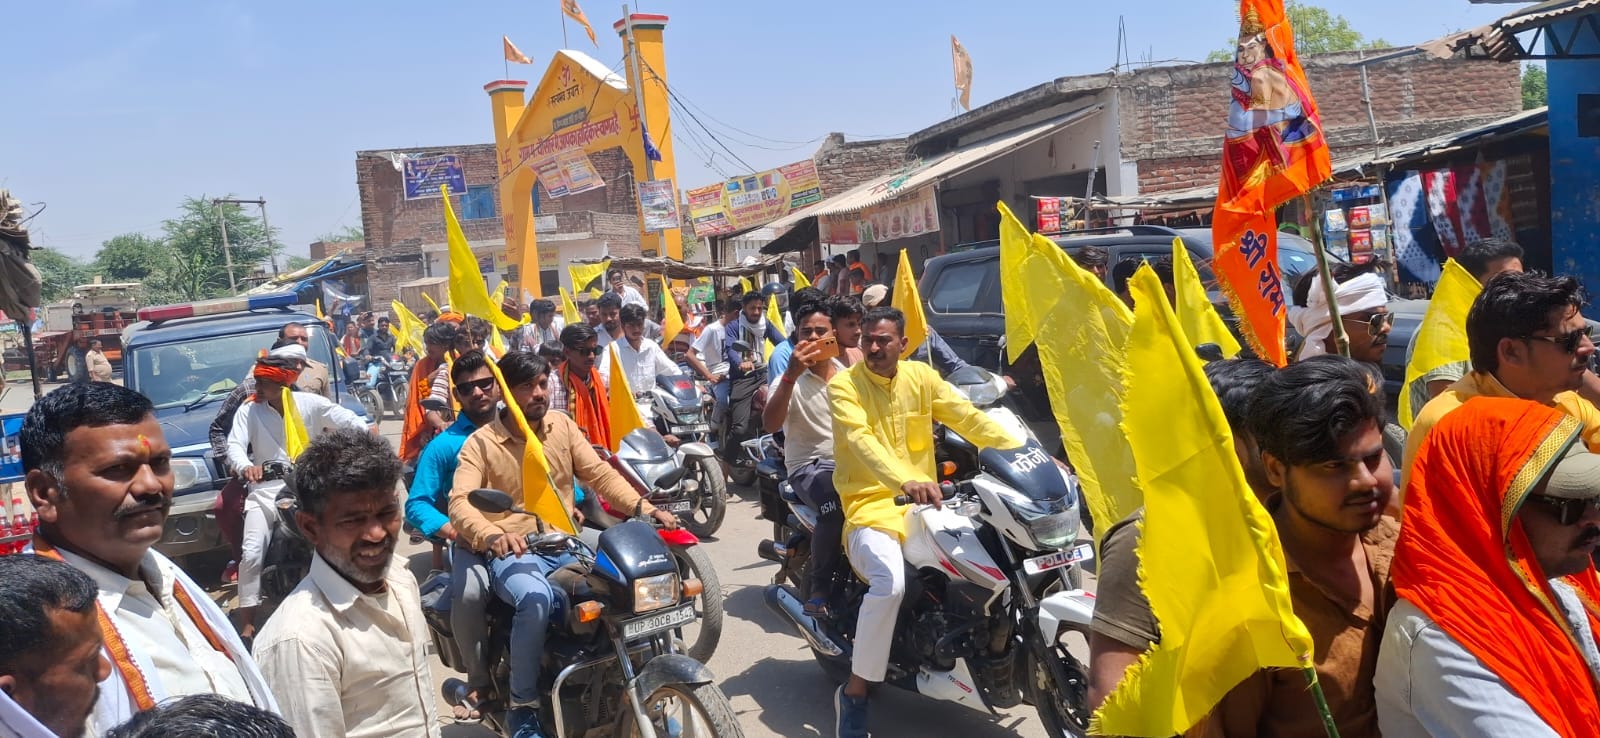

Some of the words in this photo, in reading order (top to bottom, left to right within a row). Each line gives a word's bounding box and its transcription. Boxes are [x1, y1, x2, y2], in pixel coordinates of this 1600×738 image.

[1239, 229, 1268, 270] श्री
[1258, 261, 1285, 316] राम
[1009, 446, 1050, 473] फौजी
[1036, 548, 1083, 569] POLICE
